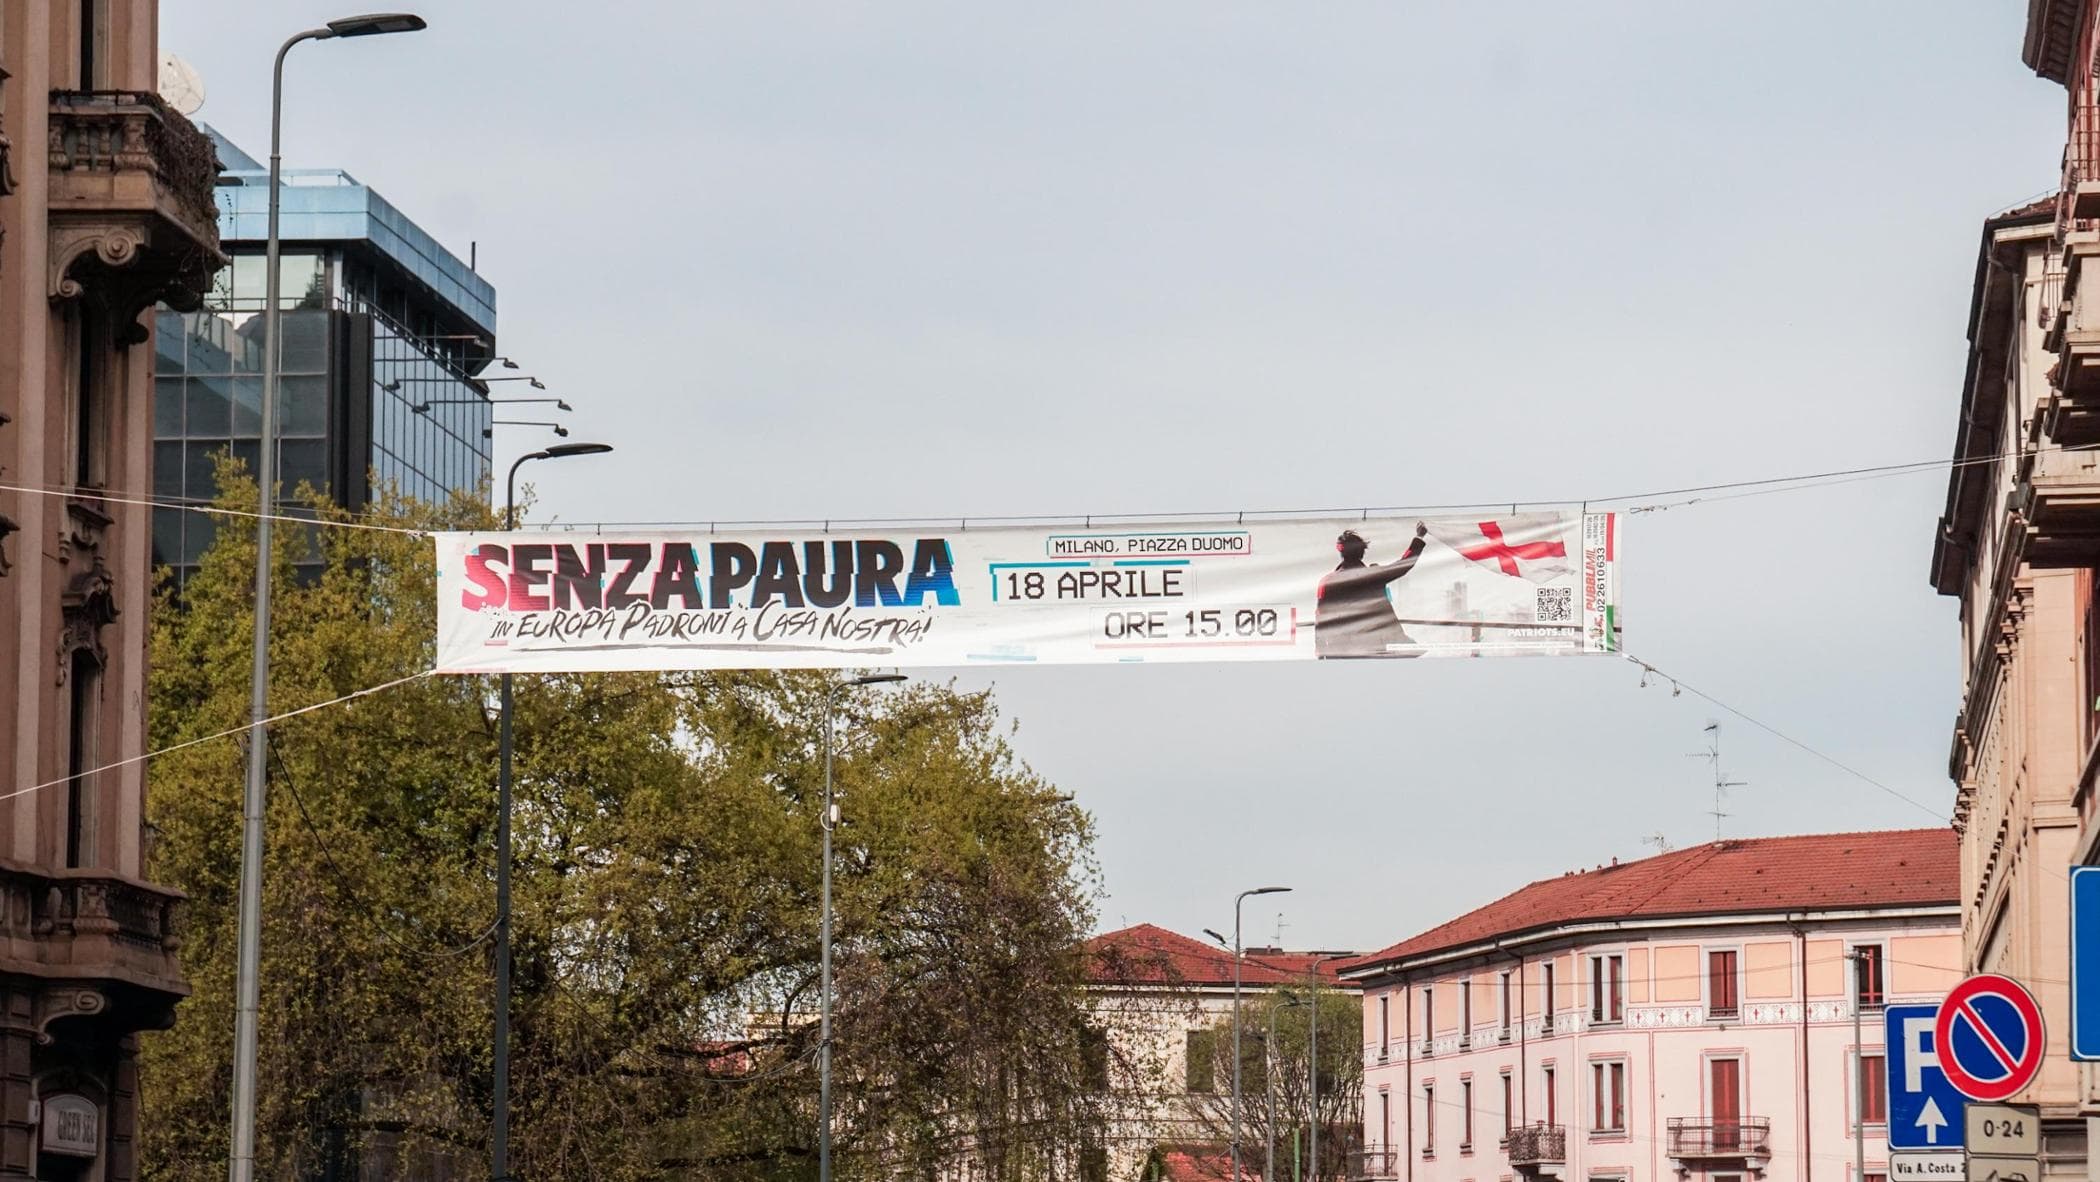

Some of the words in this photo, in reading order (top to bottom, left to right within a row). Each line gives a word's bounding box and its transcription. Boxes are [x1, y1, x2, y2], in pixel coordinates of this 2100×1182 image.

[1055, 539, 1120, 553] MILANO,
[1128, 538, 1187, 553] PIAZZA
[1192, 537, 1243, 551] DUOMO
[462, 543, 703, 610] SENZA
[709, 539, 962, 610] PAURA
[1008, 571, 1045, 600] 18
[1057, 570, 1183, 599] APRILE
[1585, 550, 1597, 612] PUBBLIMIL
[618, 600, 732, 641] PADRONI
[753, 600, 819, 642] CASA
[820, 605, 932, 648] NOSTRA!
[1104, 611, 1168, 638] ORE
[1185, 609, 1277, 637] 15.00
[1507, 627, 1575, 638] PATRIOTS.EU
[1903, 1017, 1938, 1092] P
[1983, 1119, 2024, 1138] 0-24
[1896, 1163, 1912, 1174] Via
